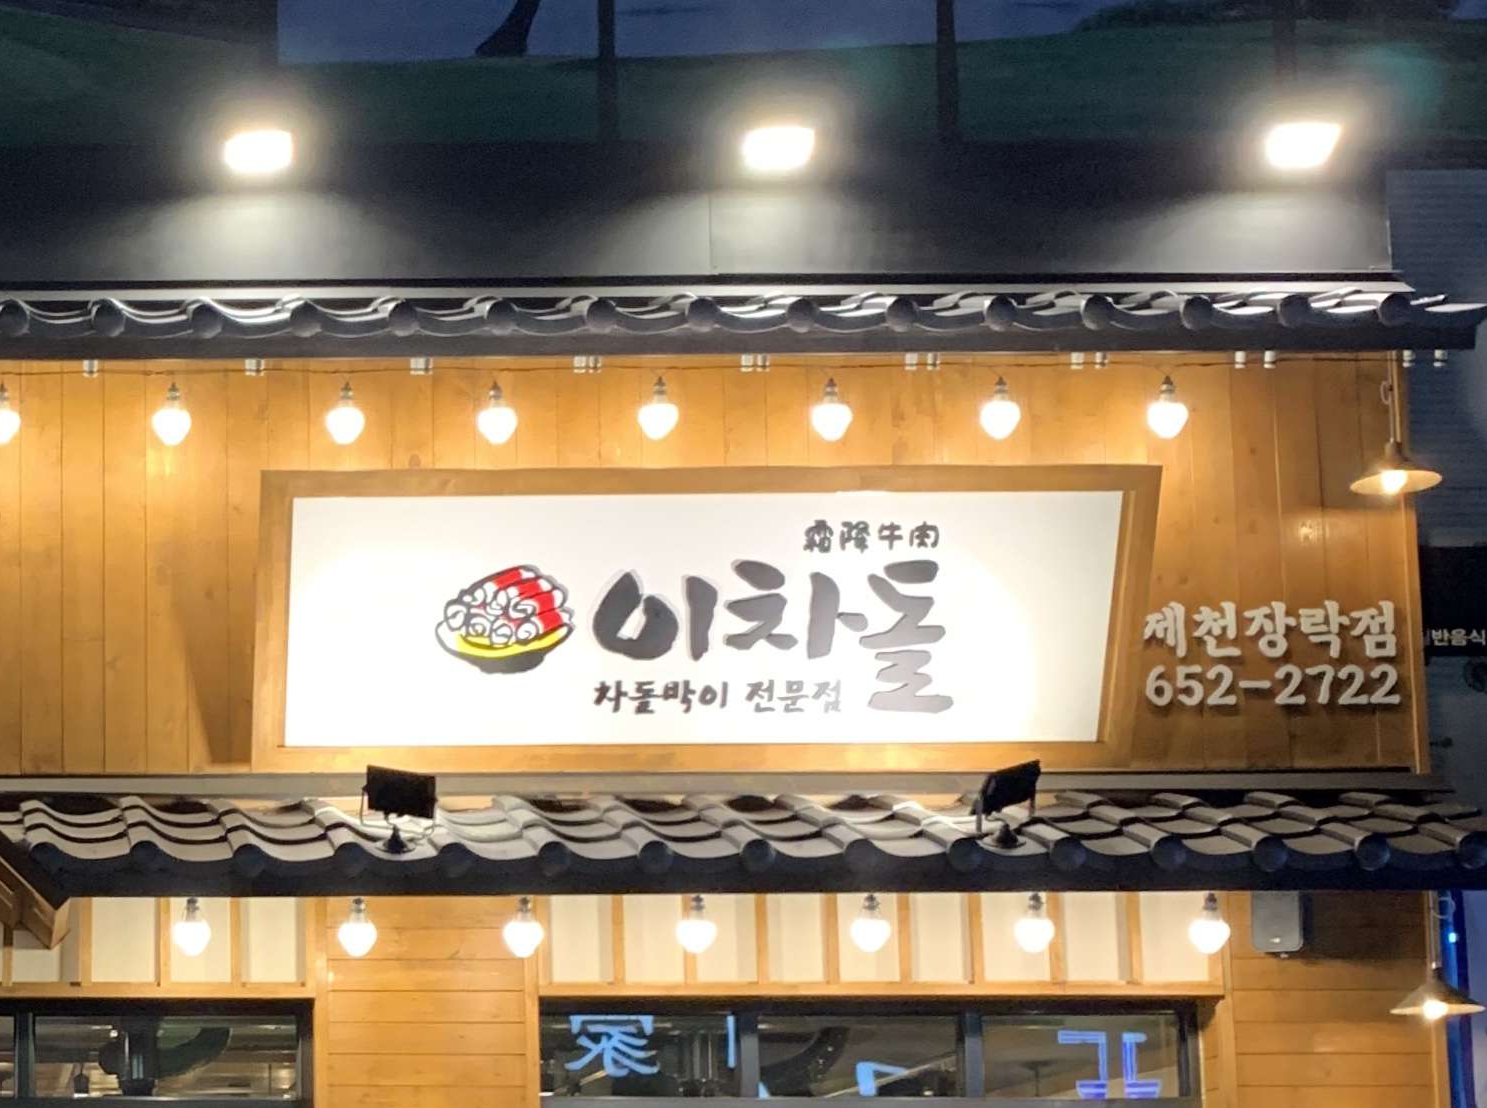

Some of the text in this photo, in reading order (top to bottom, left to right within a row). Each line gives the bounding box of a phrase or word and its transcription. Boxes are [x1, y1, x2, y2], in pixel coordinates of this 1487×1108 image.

[803, 519, 940, 553] 霜降牛肉
[592, 558, 954, 714] 이차돌
[1143, 600, 1397, 659] 제천장락점
[1425, 627, 1486, 646] 반음식
[593, 677, 842, 714] 차돌박이 전문점
[1145, 664, 1401, 706] 652-2722
